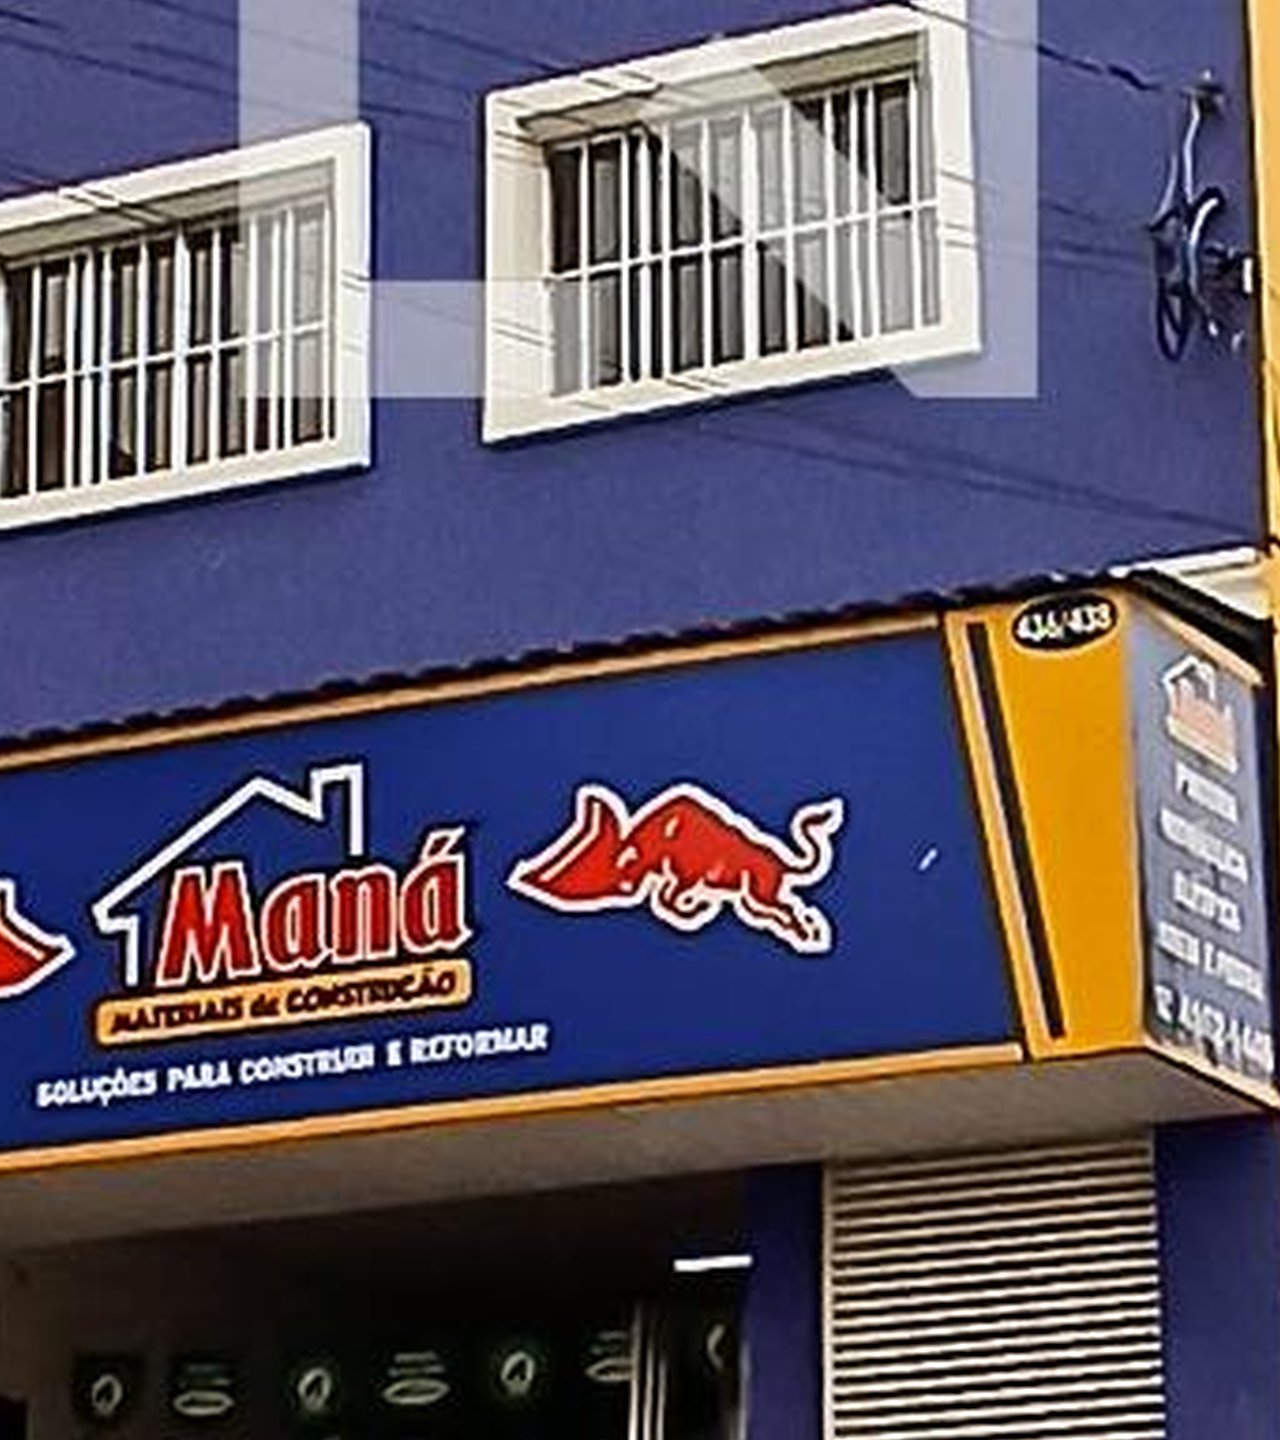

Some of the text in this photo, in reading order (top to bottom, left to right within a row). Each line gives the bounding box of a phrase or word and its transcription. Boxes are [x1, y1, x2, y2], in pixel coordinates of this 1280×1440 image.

[156, 826, 473, 987] Maná
[166, 1061, 232, 1091] PARA
[387, 1040, 403, 1066] E
[410, 1023, 549, 1063] REFORMAR
